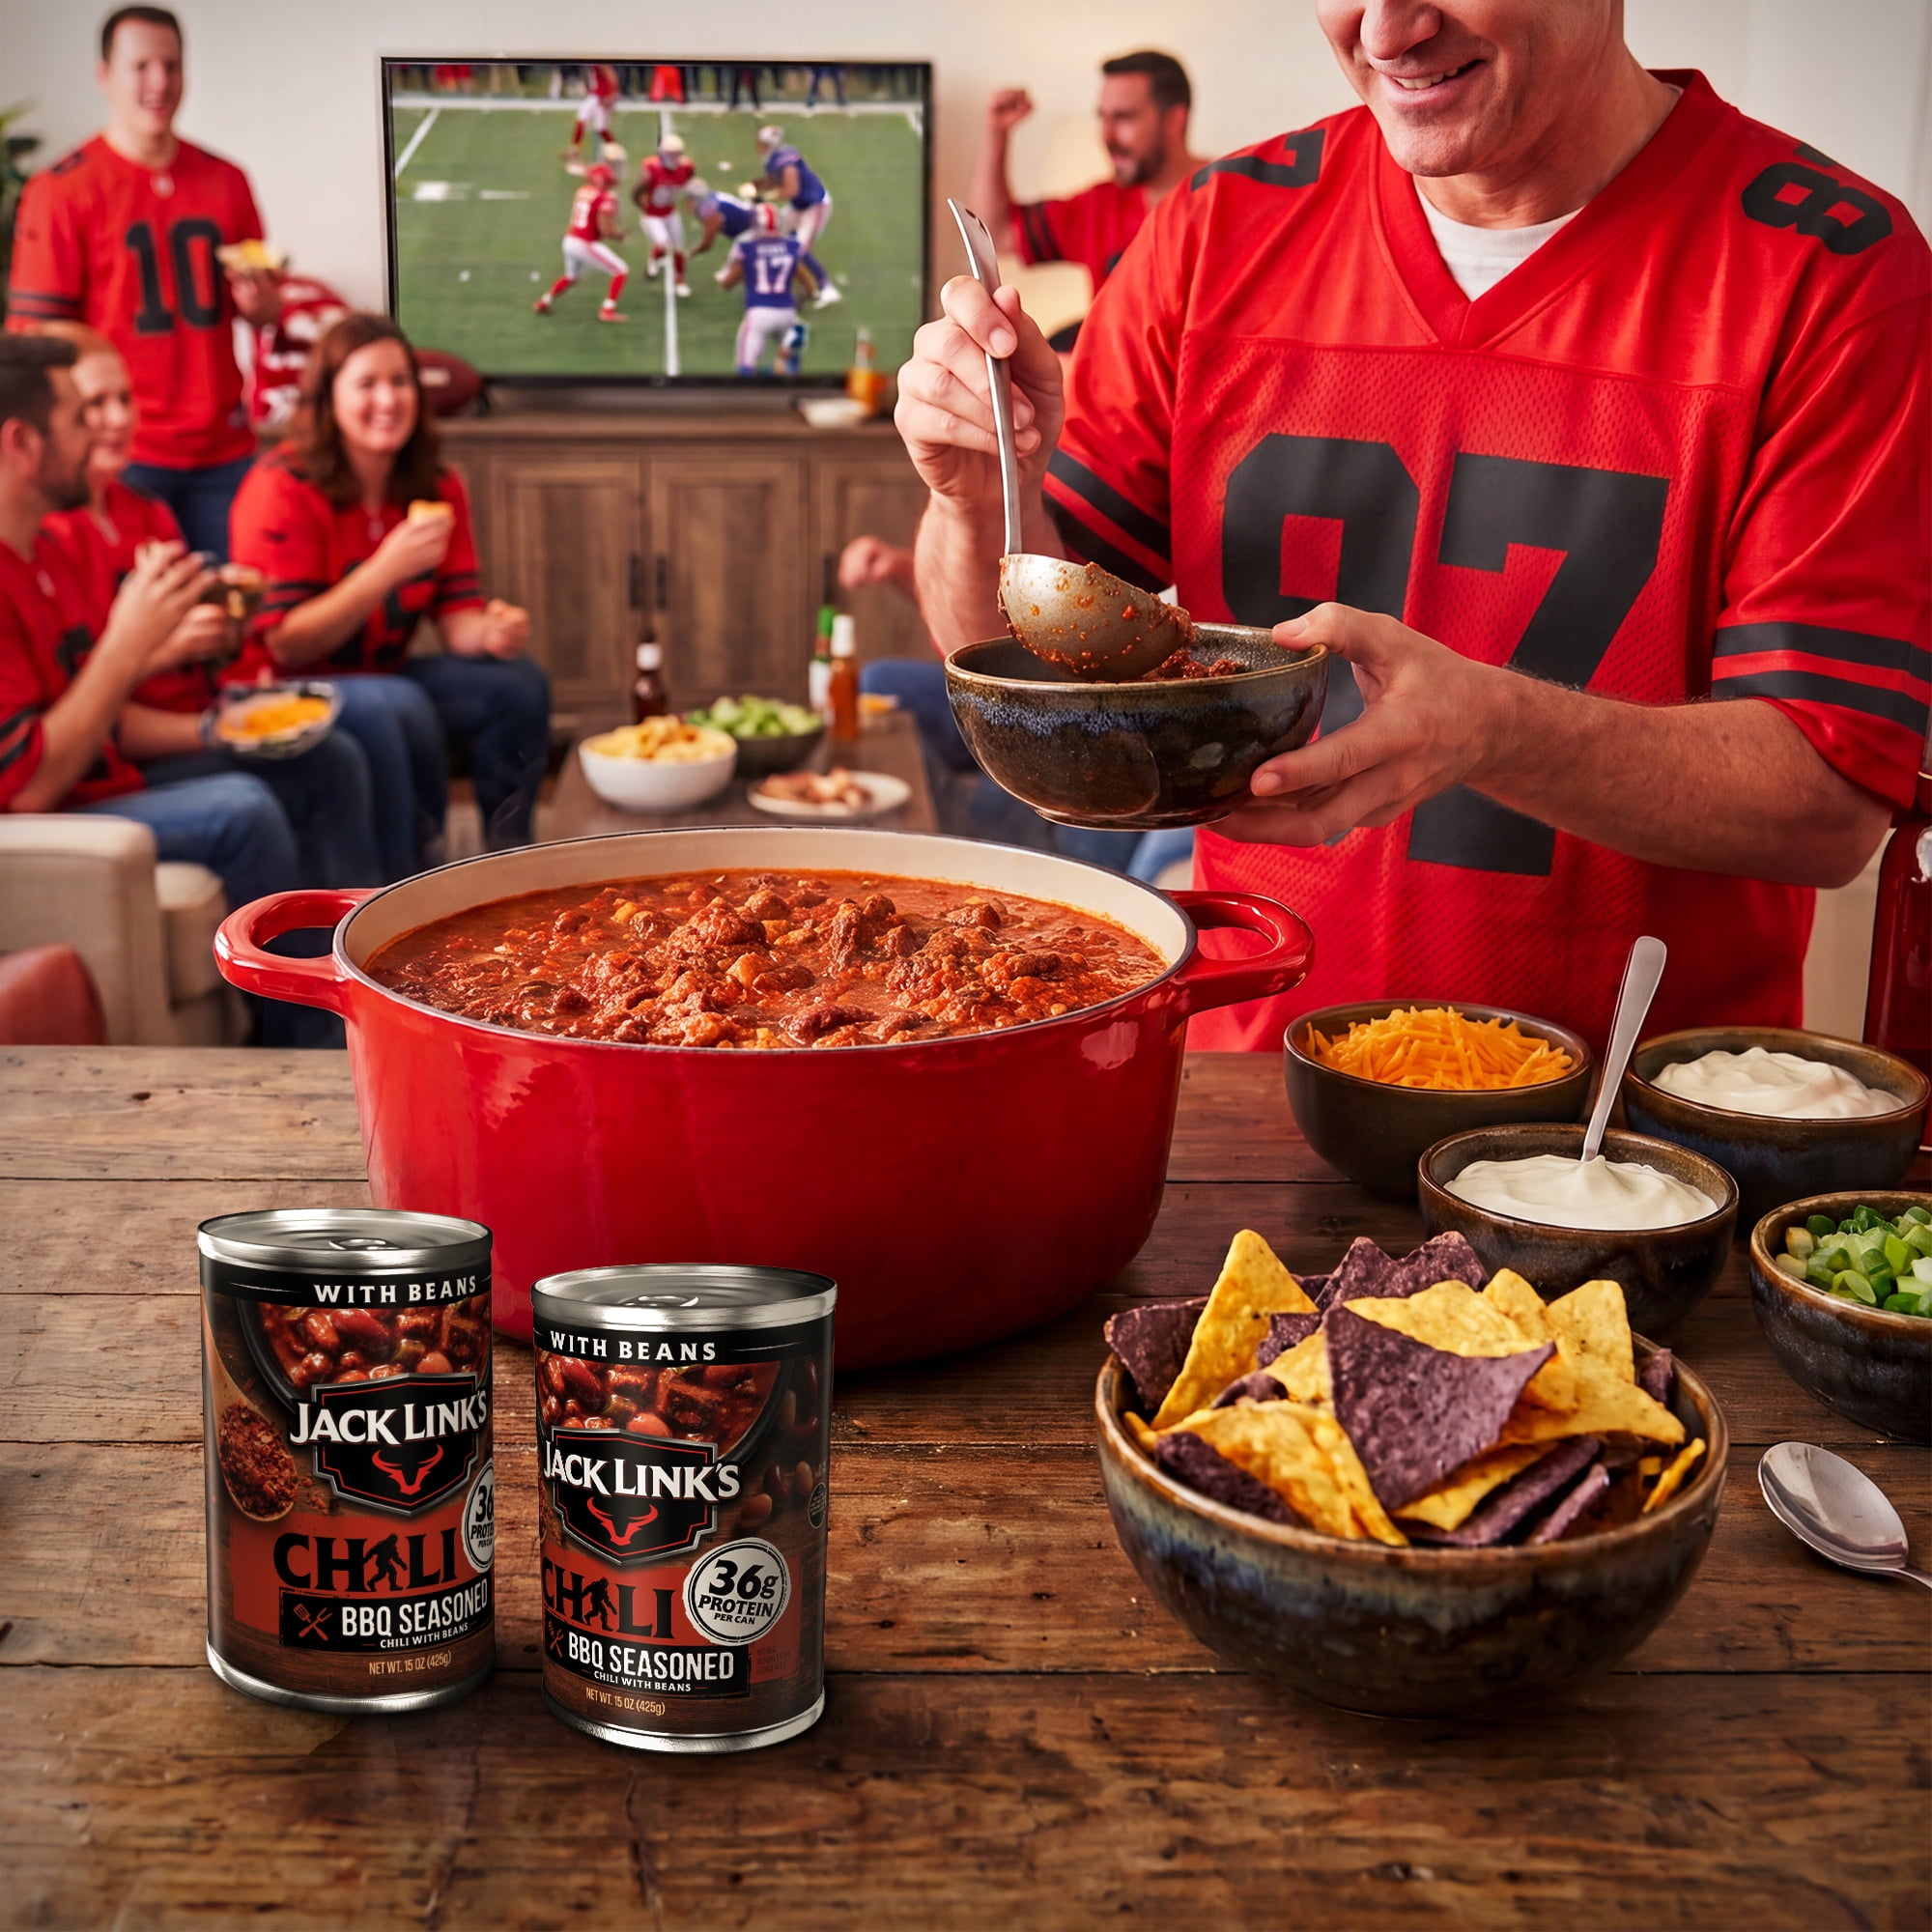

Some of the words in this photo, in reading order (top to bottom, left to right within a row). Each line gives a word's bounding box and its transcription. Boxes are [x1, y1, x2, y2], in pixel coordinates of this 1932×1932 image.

[1741, 142, 1893, 255] 8
[125, 217, 222, 333] 10
[753, 254, 794, 294] 17
[313, 1285, 397, 1304] WITH
[408, 1275, 476, 1302] BEANS
[550, 1330, 608, 1357] WITH
[618, 1340, 716, 1361] BEANS
[290, 1402, 400, 1445] JACK
[404, 1389, 488, 1441] LINK'S
[543, 1440, 611, 1496] JACK
[613, 1458, 741, 1501] LINK'S
[470, 1521, 494, 1540] PROTE
[708, 1559, 780, 1601] 36g
[342, 1606, 392, 1637] BBQ
[399, 1578, 488, 1634] SEASONED
[697, 1595, 775, 1618] PROTEIN
[714, 1612, 733, 1623] PER
[734, 1615, 756, 1625] CAN
[380, 1637, 410, 1649] CHILI
[412, 1632, 440, 1645] WITH
[441, 1622, 469, 1639] BEANS
[369, 1661, 385, 1675] NET
[386, 1660, 403, 1674] WT.
[404, 1659, 414, 1672] 15
[414, 1657, 425, 1671] OZ
[426, 1651, 451, 1669] (425g)
[568, 1632, 604, 1670] BBQ
[609, 1644, 734, 1681] SEASONED
[593, 1670, 618, 1685] CHILI
[620, 1676, 652, 1690] WITH
[654, 1682, 692, 1692] BEANS
[585, 1687, 599, 1701] NET
[599, 1690, 613, 1706] WT.
[613, 1694, 624, 1708] 15
[624, 1696, 635, 1711] OZ
[636, 1698, 666, 1716] (425g)
